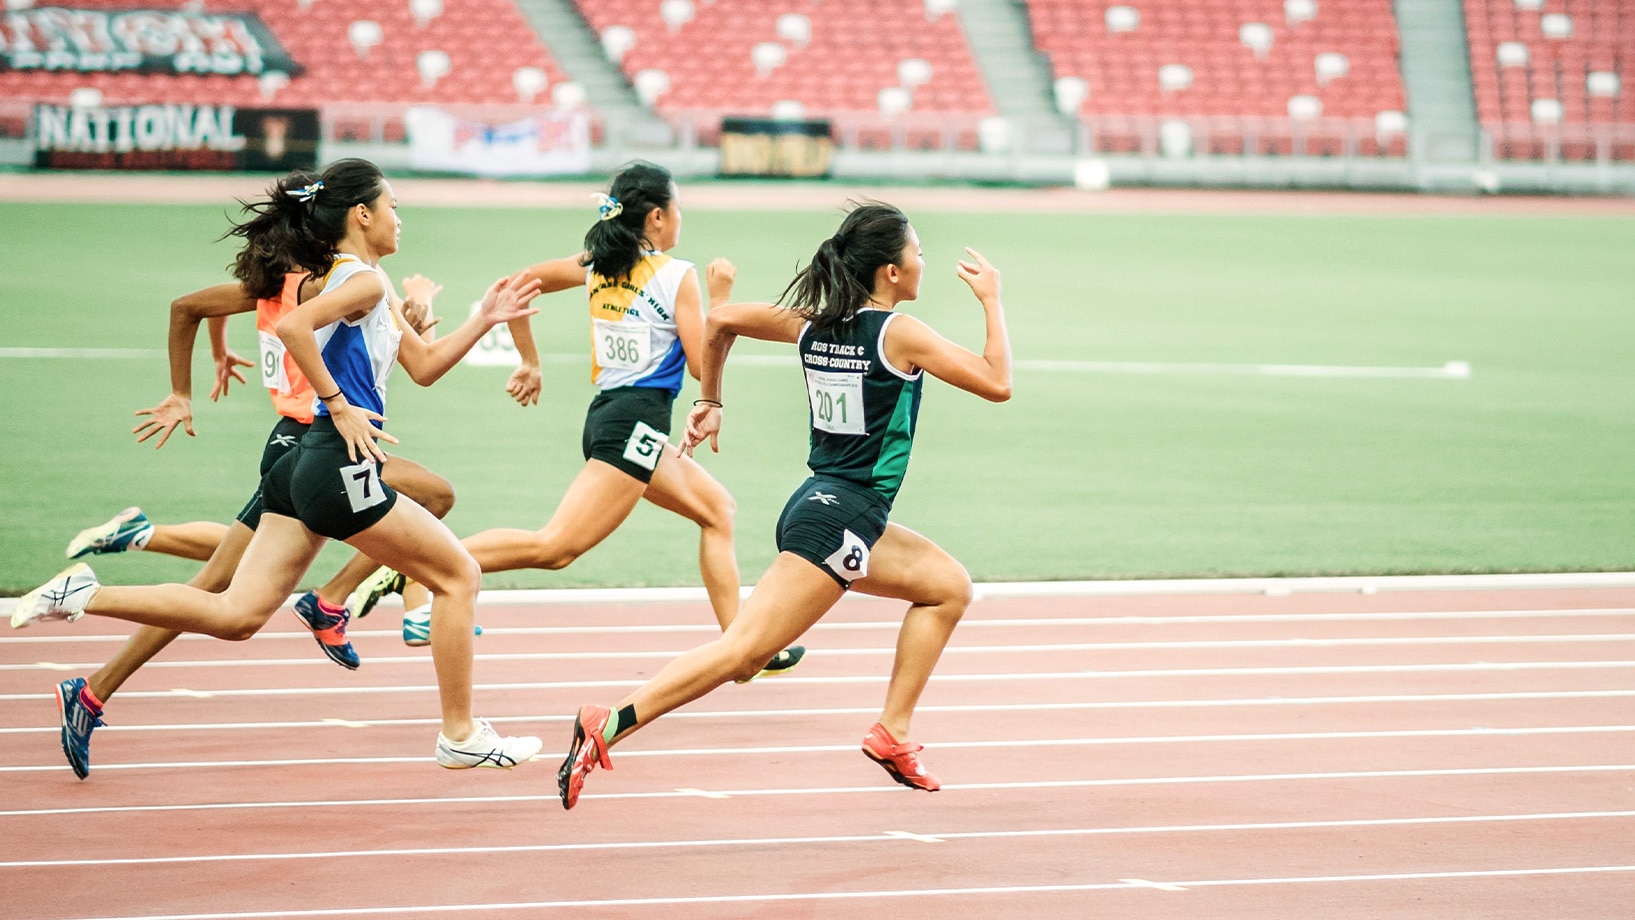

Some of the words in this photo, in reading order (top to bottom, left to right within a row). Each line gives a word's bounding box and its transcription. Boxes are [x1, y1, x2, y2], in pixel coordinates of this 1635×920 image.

[39, 104, 247, 152] NATIONAL
[602, 303, 640, 317] ATHLETICS
[605, 335, 640, 364] 386
[804, 353, 871, 370] CROSS-COUNTRY
[829, 344, 855, 355] TRACK
[815, 389, 848, 424] 201
[636, 433, 657, 457] 5
[353, 469, 371, 499] 7
[842, 544, 863, 571] 8
